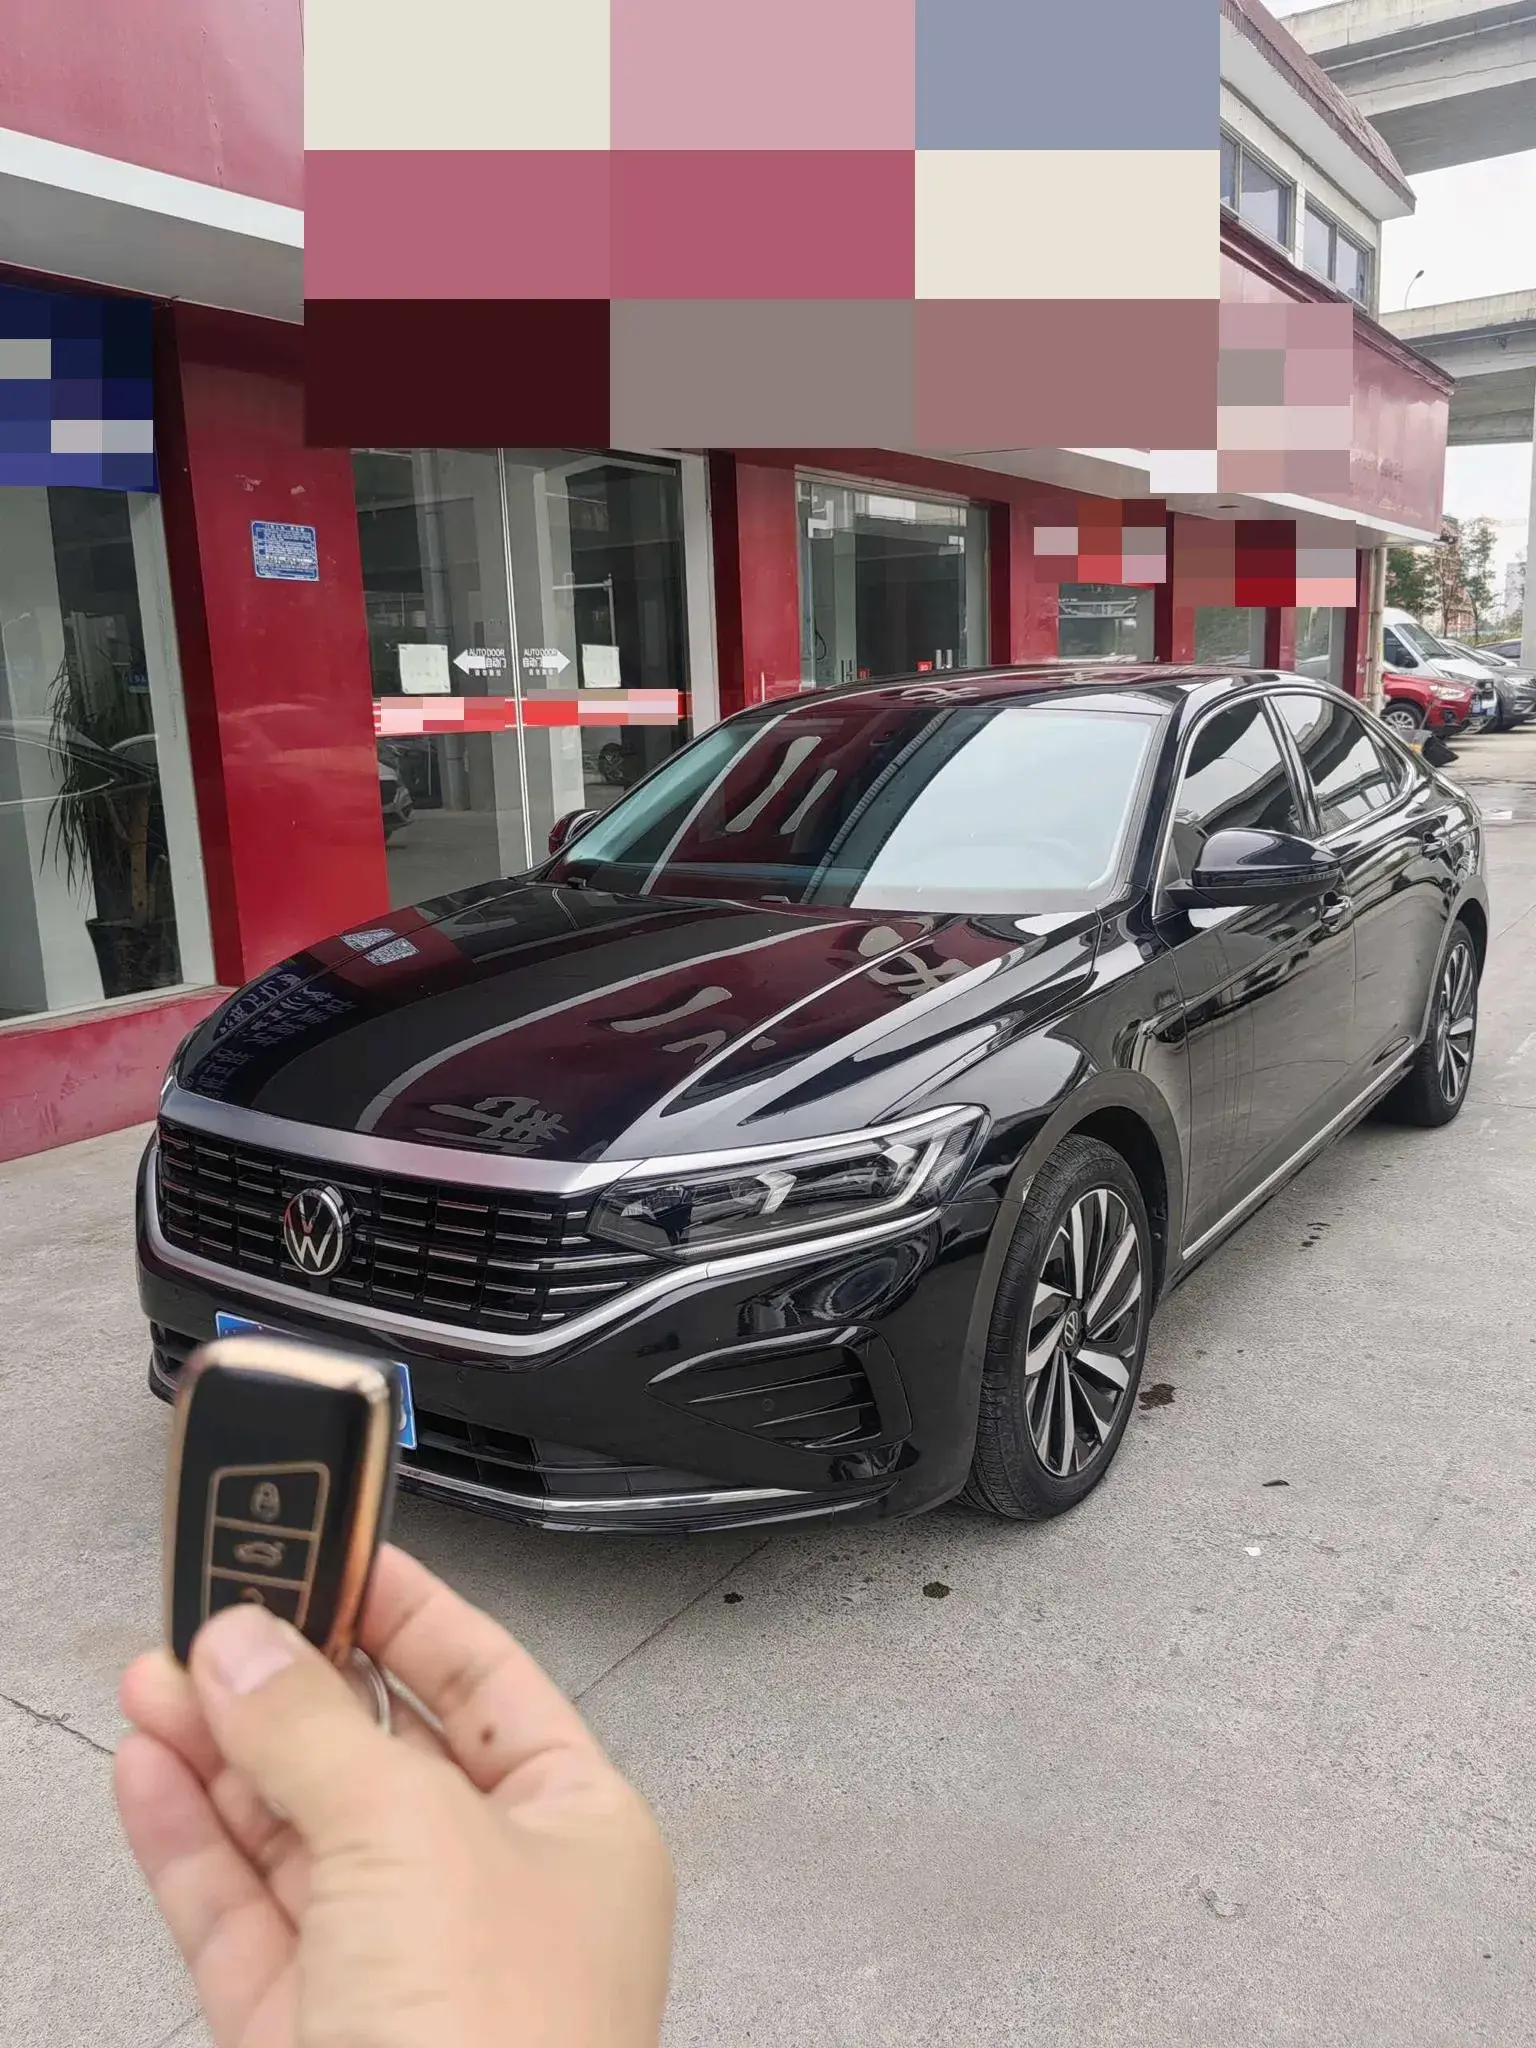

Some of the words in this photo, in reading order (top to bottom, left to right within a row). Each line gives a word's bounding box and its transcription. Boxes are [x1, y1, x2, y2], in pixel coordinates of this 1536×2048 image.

[468, 648, 486, 657] AUTO
[487, 648, 505, 657] DOOR
[524, 648, 541, 656] AUTO
